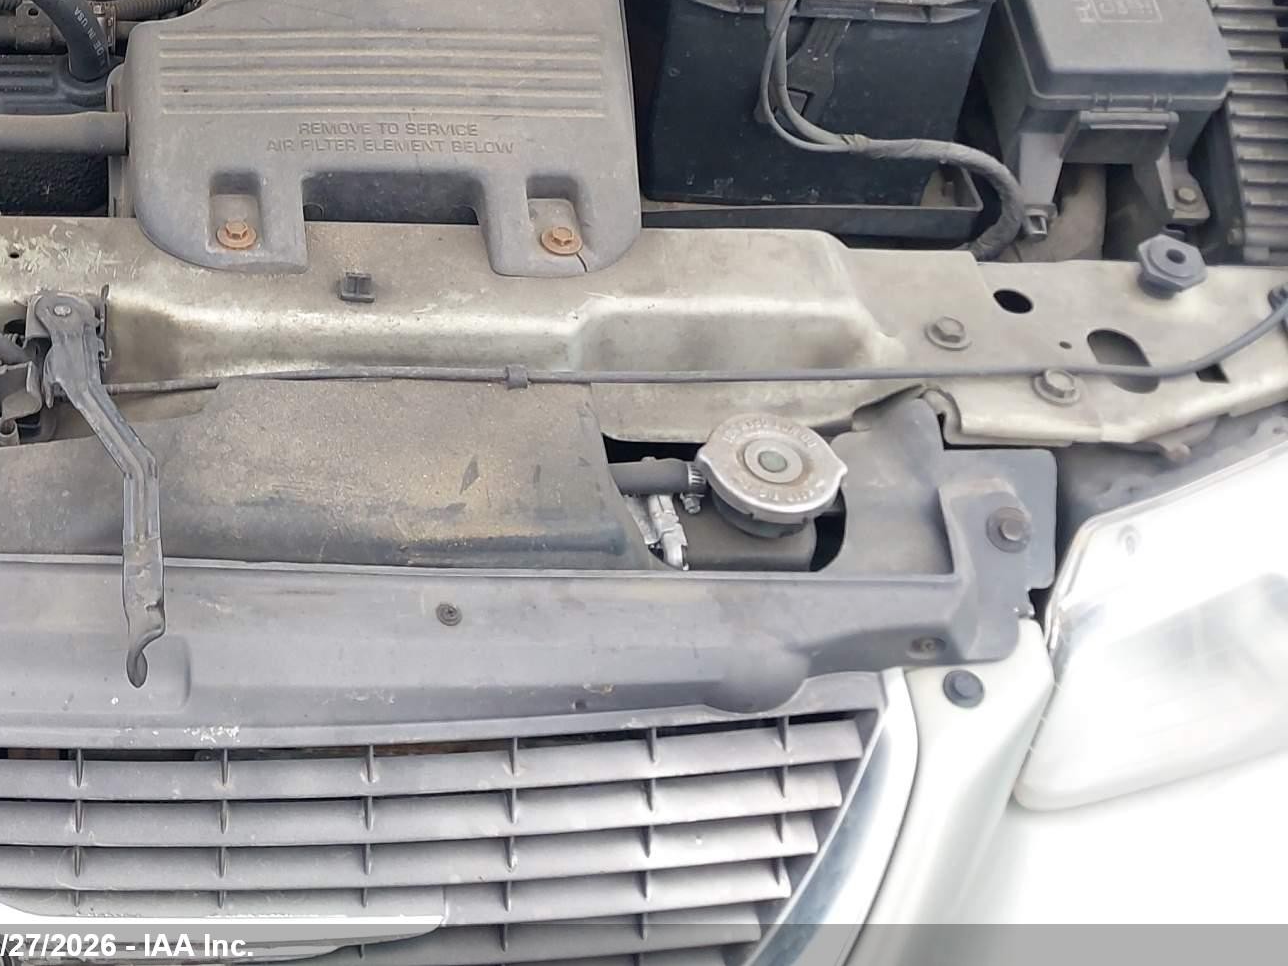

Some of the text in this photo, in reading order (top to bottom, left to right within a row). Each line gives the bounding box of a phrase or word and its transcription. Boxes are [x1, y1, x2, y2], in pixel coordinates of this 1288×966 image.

[74, 6, 88, 27] USA
[299, 122, 479, 136] REMOVE TO SERVICE
[266, 139, 514, 154] AIR FILTER ELEMENT BELOW
